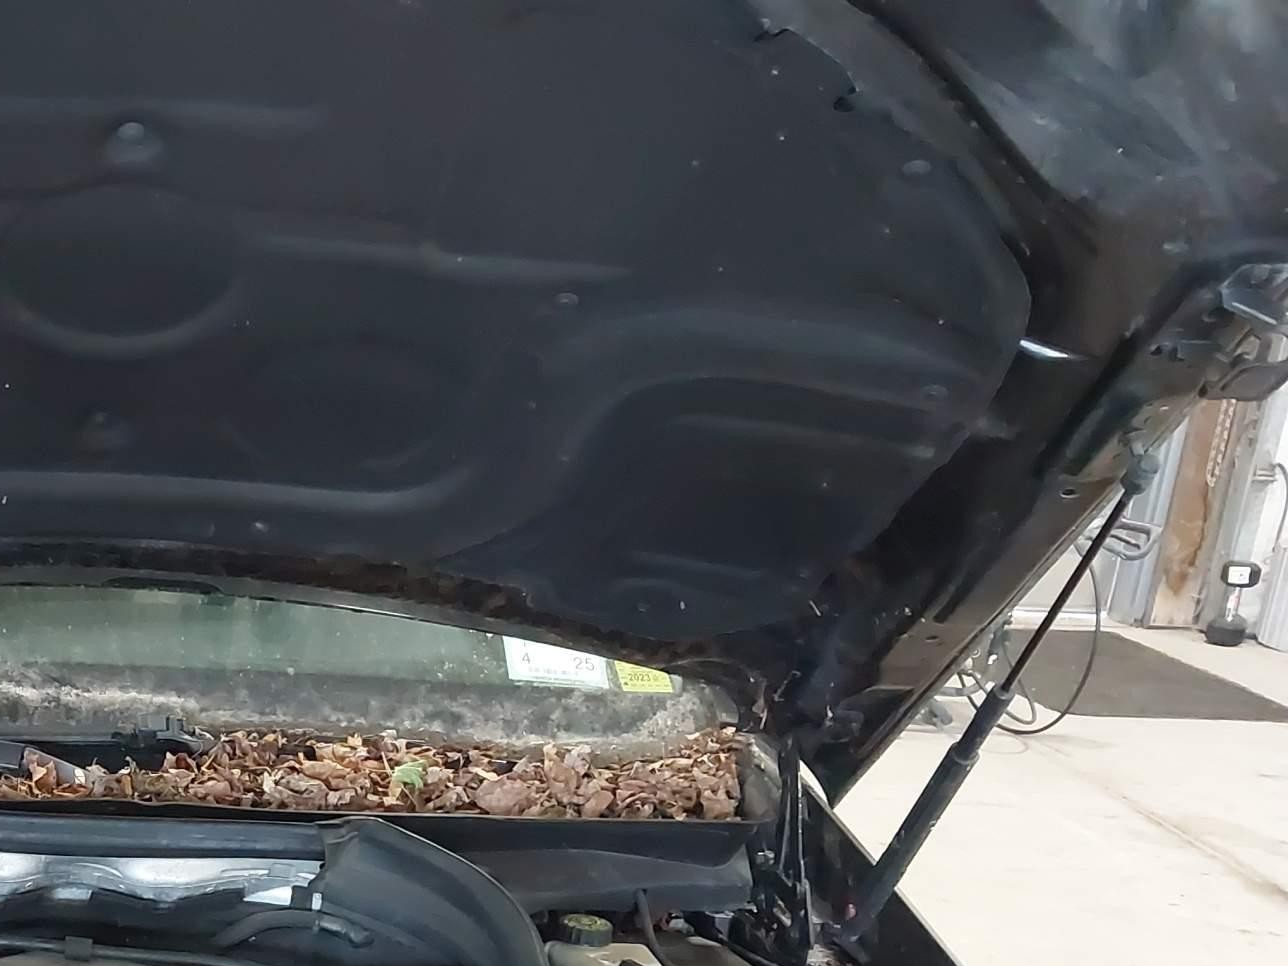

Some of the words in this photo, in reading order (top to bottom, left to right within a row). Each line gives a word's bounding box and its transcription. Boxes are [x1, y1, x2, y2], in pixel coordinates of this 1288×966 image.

[521, 652, 531, 665] 4
[572, 656, 595, 672] 25
[627, 672, 651, 682] 2023
